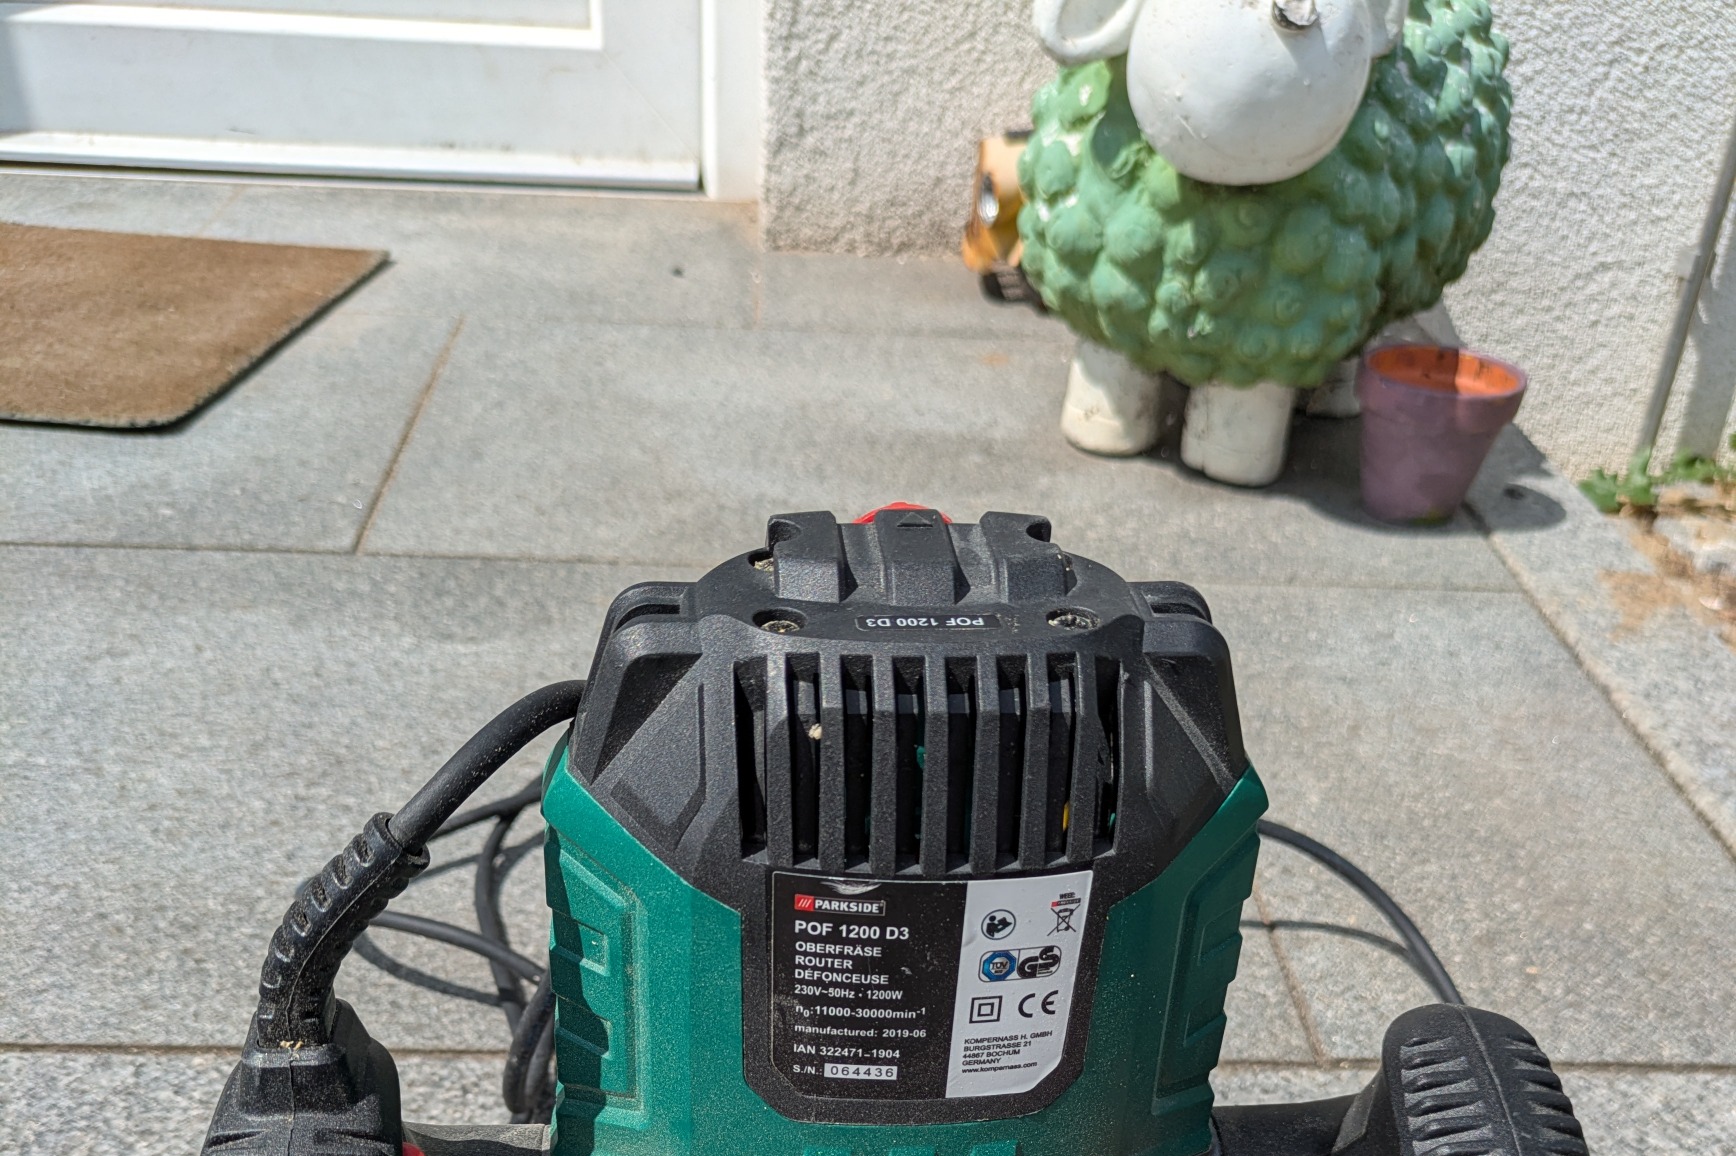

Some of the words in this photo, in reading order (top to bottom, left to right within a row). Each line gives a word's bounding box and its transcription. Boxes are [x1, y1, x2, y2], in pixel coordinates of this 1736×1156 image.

[866, 618, 891, 628] D3
[896, 617, 939, 627] 1200
[945, 616, 984, 627] POF
[815, 899, 880, 913] PARKSIDE
[794, 920, 834, 936] POF
[839, 924, 880, 940] 1200
[886, 926, 910, 940] D3
[795, 940, 882, 957] OBERFRÄSE
[795, 955, 853, 969] ROUTER
[1017, 946, 1061, 978] GS
[794, 968, 890, 984] DÉFONCEUSE
[794, 984, 856, 999] 230V~50Hz
[866, 990, 903, 1000] 1200W
[1018, 990, 1058, 1018] CE
[794, 1024, 878, 1038] manufactured:
[882, 1028, 927, 1038] 2019-06
[964, 1035, 1018, 1044] KOMPERNASS
[1030, 1030, 1053, 1039] GMBH
[793, 1044, 816, 1054] IAN
[964, 1042, 1022, 1052] BURGSTRASSE
[986, 1049, 1020, 1058] BOCHUM
[962, 1058, 1002, 1066] GERMANY
[830, 1066, 894, 1078] 064436
